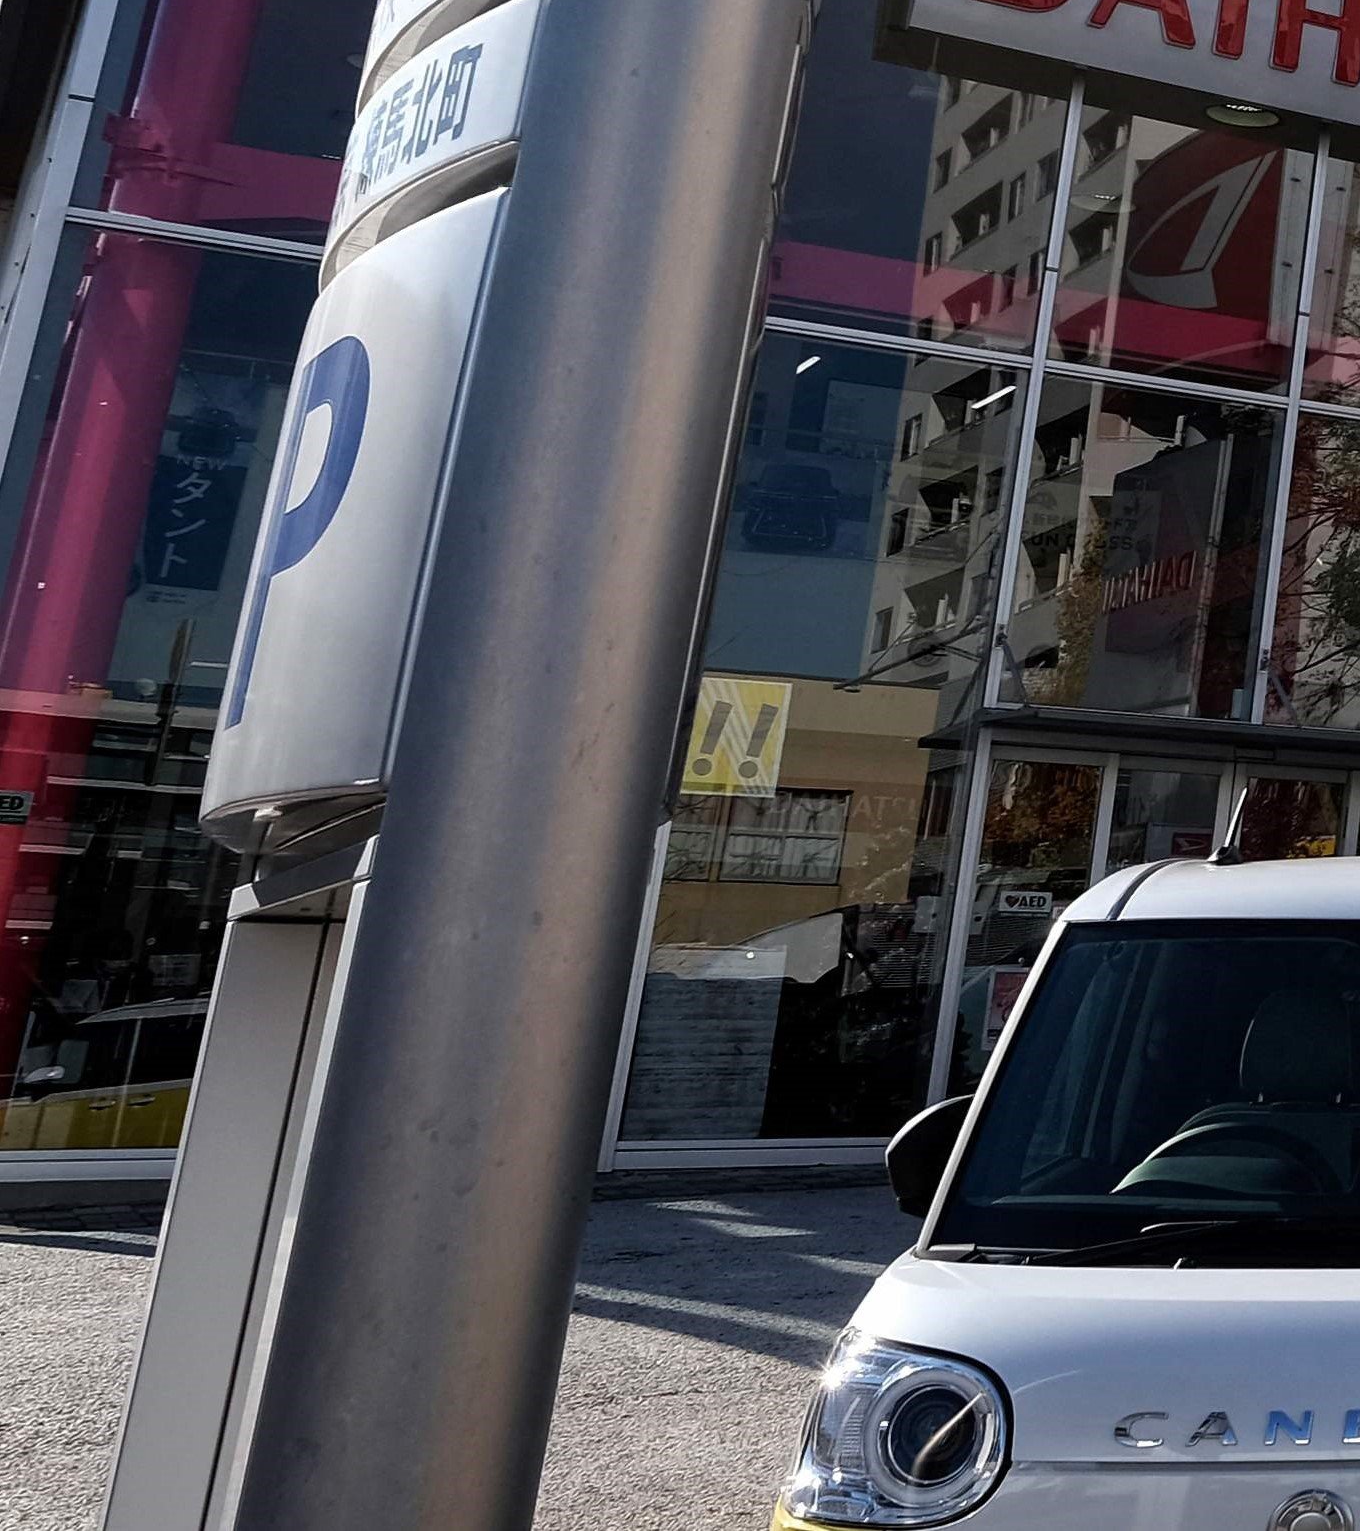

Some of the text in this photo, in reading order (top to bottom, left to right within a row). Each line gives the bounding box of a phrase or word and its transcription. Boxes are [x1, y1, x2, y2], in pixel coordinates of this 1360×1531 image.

[160, 471, 213, 578] タント
[225, 336, 371, 730] P
[1018, 895, 1047, 909] AED
